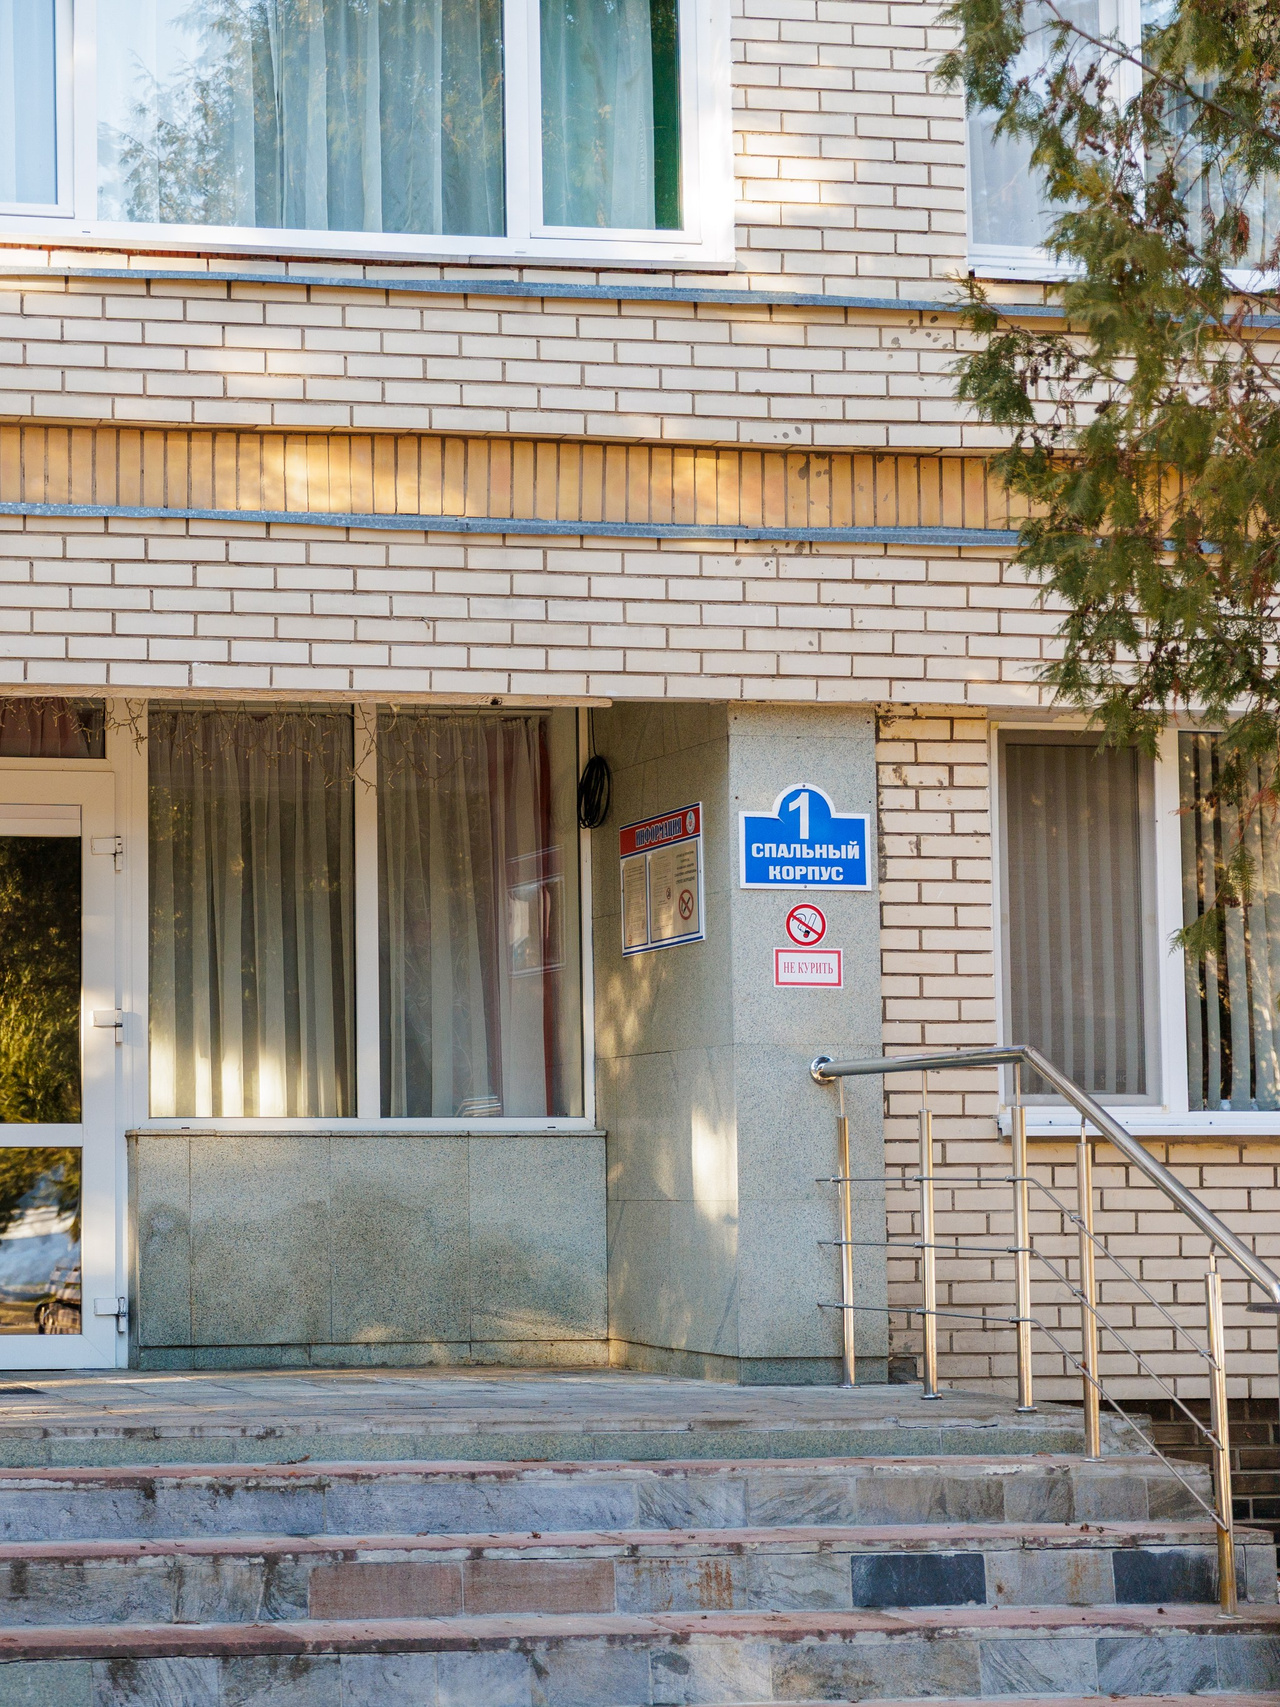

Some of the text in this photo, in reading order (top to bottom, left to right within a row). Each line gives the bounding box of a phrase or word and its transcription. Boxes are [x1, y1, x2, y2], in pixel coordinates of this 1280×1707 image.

[789, 792, 810, 840] 1
[635, 816, 682, 848] ИНФОРМАЦИЯ
[751, 840, 860, 859] СПАЛЬНЫЙ
[768, 865, 844, 881] КОРПУС
[783, 961, 834, 974] НЕ КУРИТЬ
